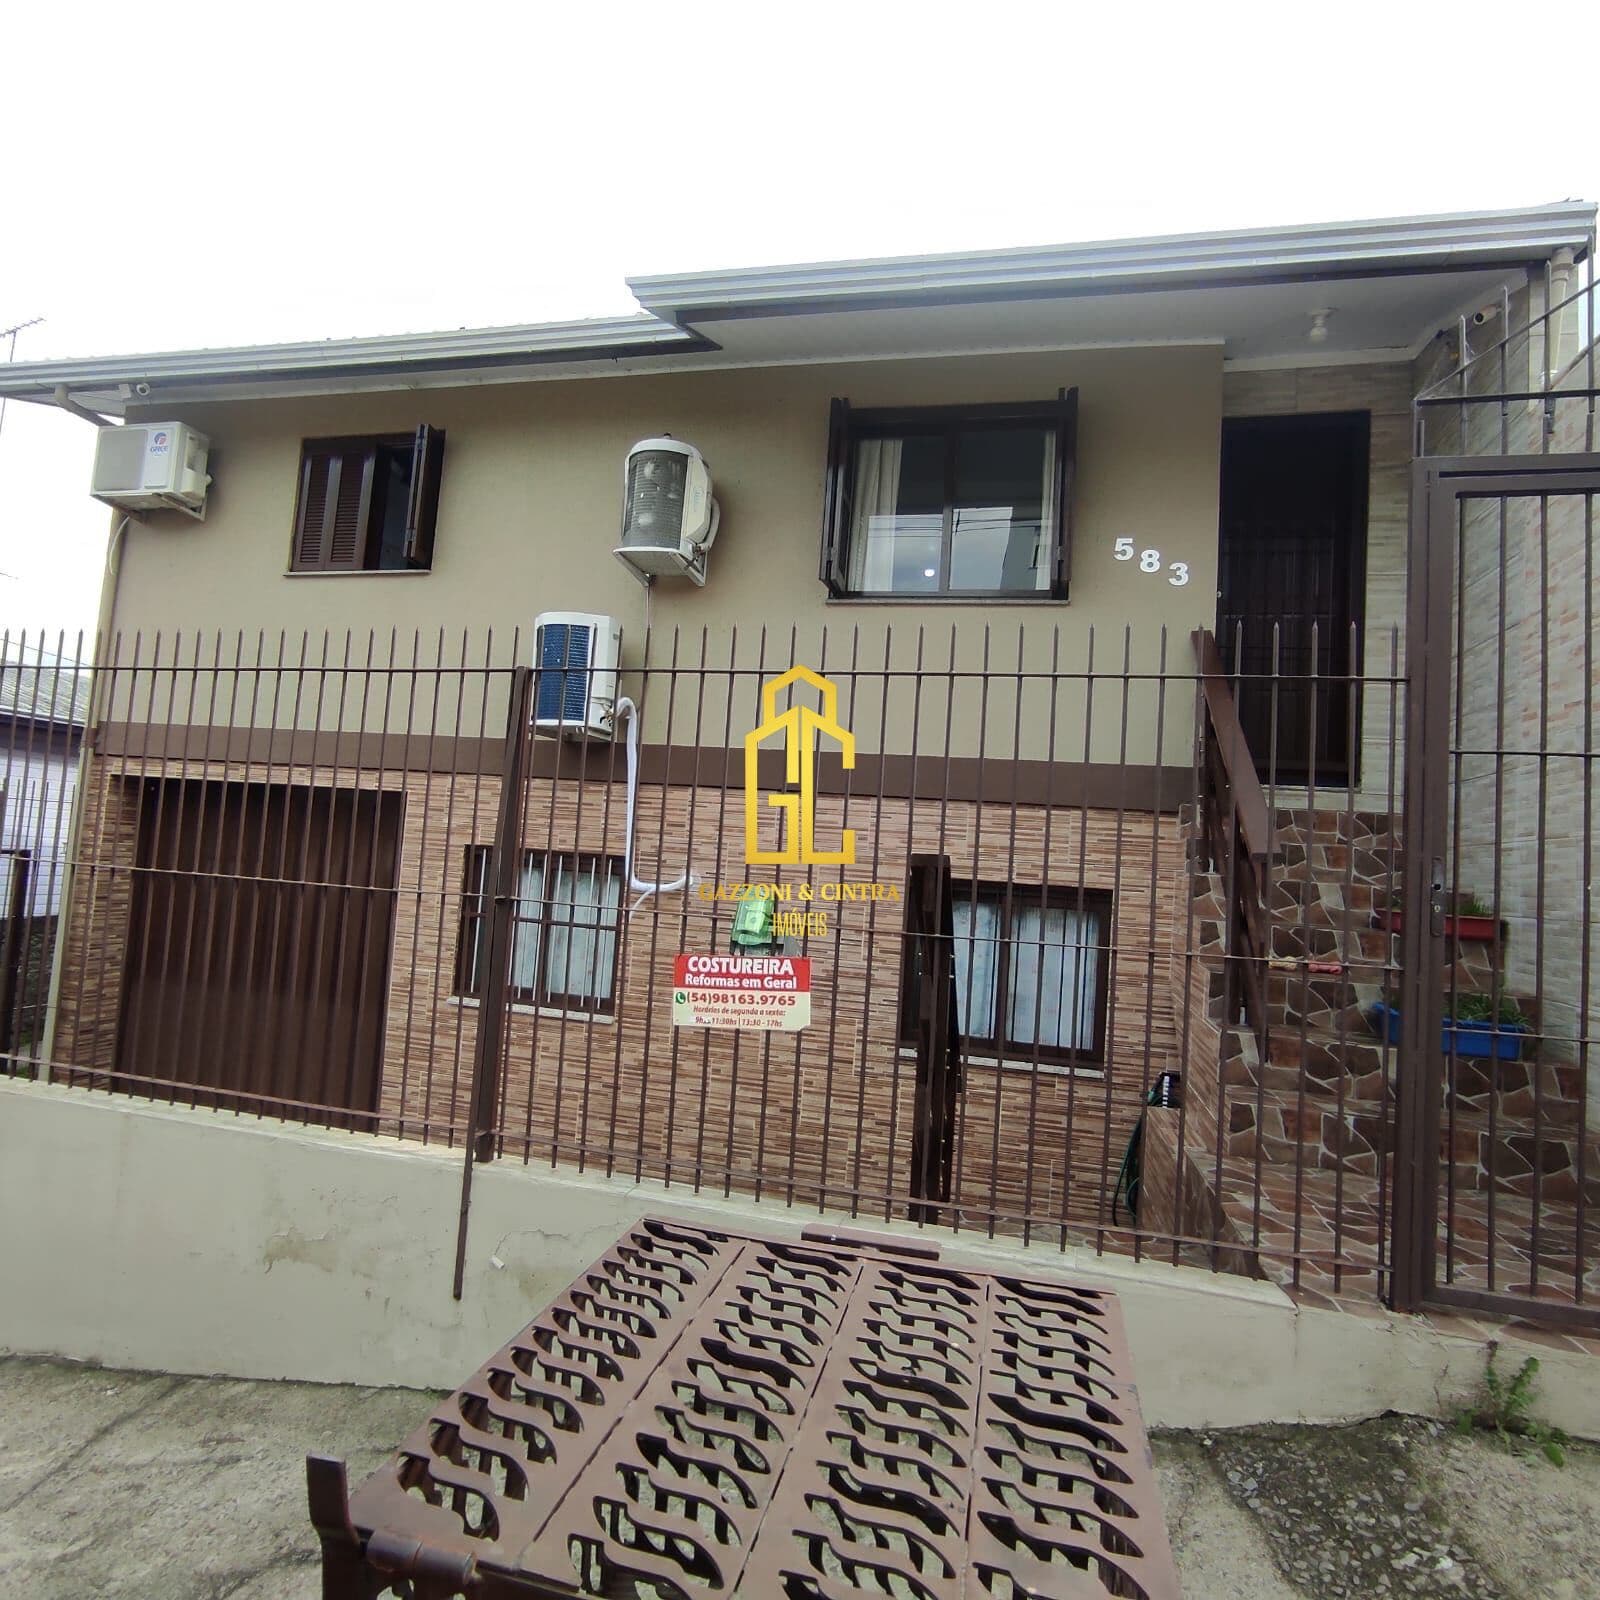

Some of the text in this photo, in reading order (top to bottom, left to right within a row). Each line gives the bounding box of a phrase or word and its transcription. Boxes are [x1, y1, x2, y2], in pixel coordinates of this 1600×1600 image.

[1113, 537, 1190, 587] 583
[687, 956, 794, 975] COSTUREIRA
[685, 974, 797, 989] Reformas em Geral
[687, 991, 796, 1006] (54)98163.9765
[731, 1008, 759, 1016] segunda
